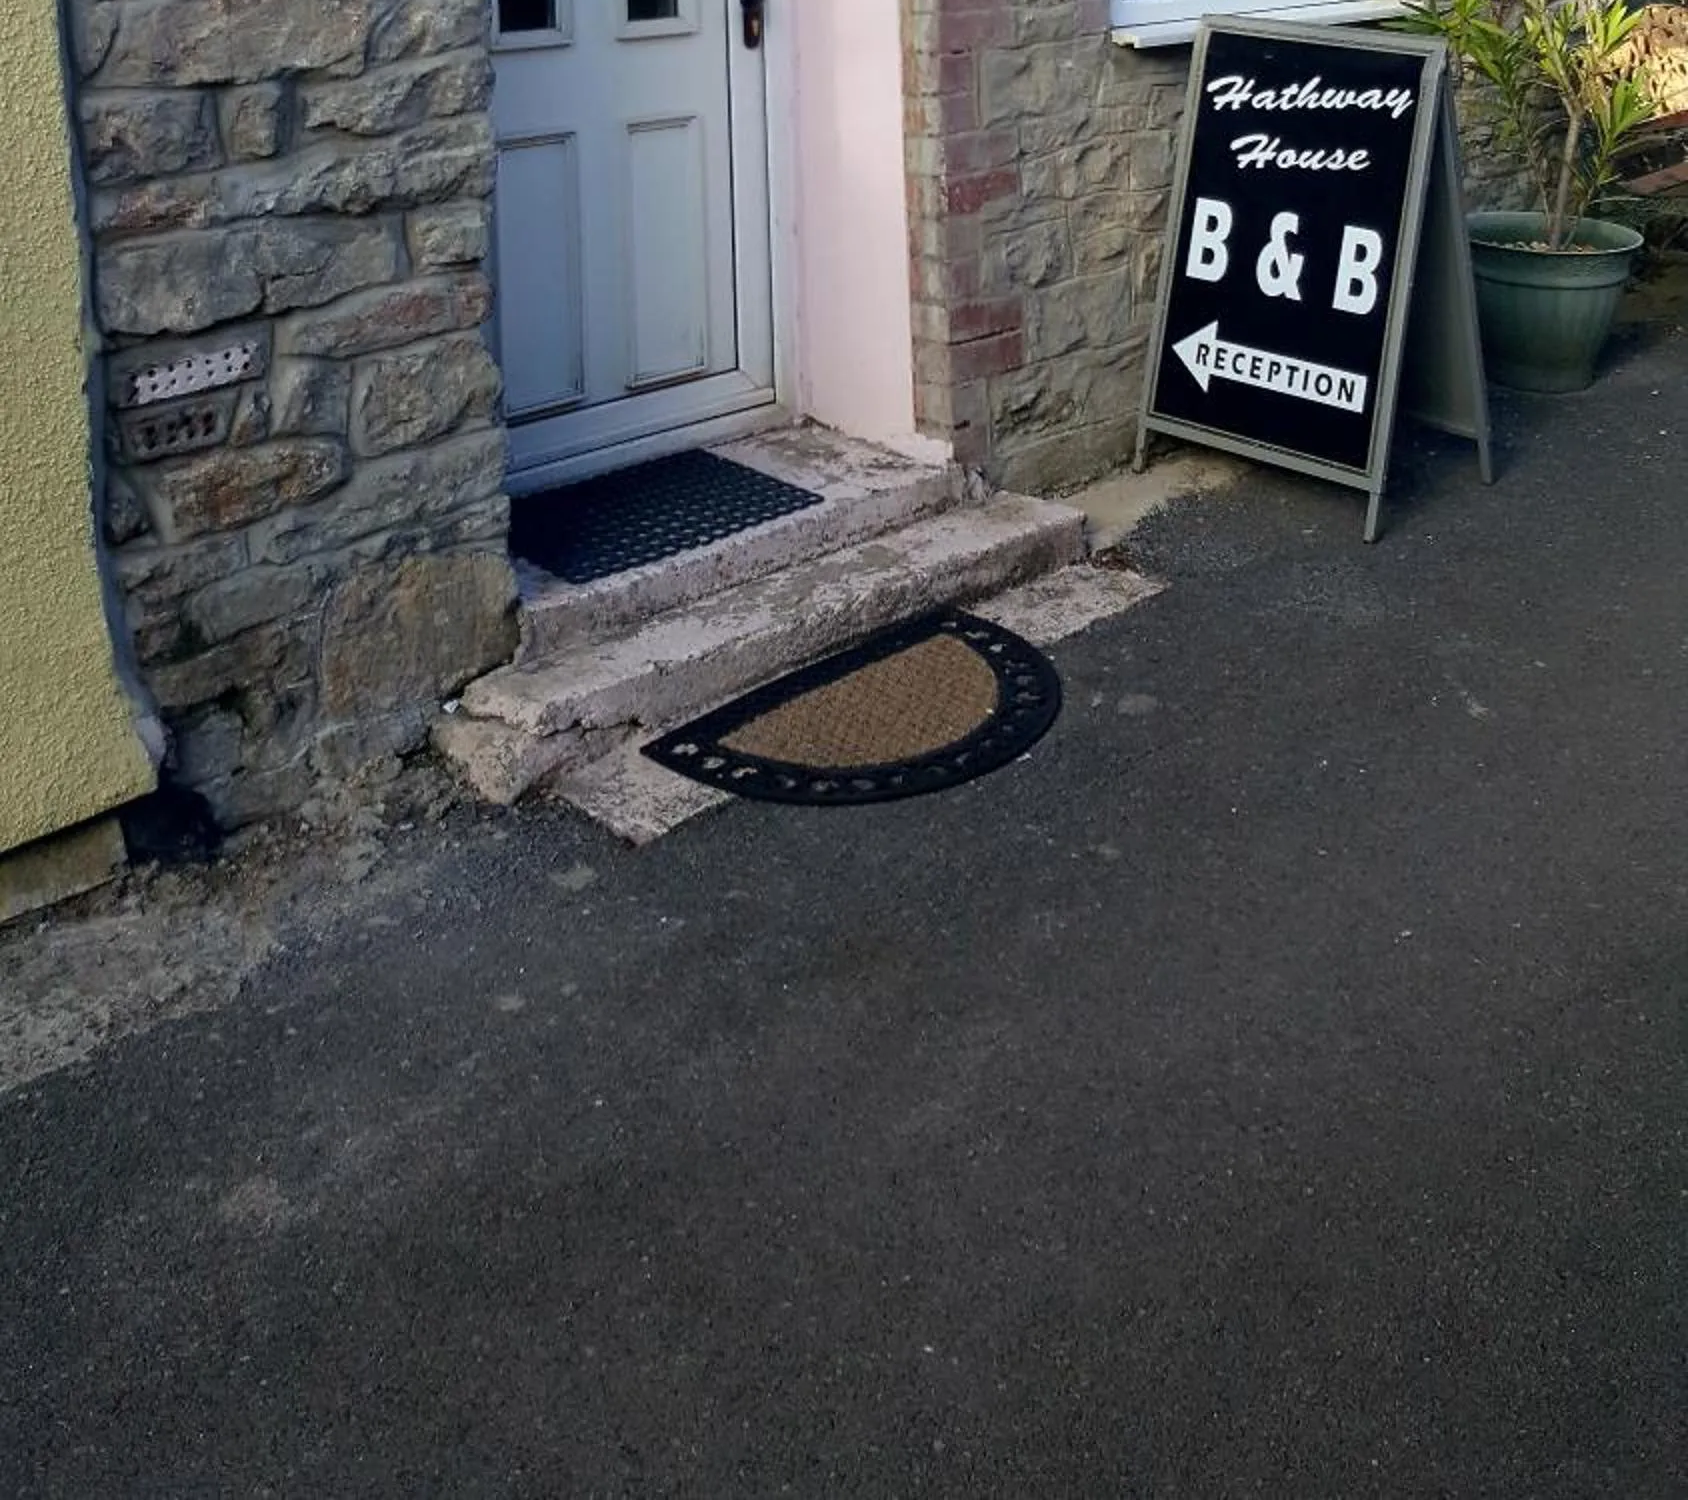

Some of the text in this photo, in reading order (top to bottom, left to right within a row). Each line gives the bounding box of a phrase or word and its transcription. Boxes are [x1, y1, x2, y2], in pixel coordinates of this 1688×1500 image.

[1207, 76, 1413, 119] Hathway
[1230, 133, 1370, 171] House
[1186, 197, 1383, 315] B & B
[1195, 343, 1356, 403] RECEPTION
